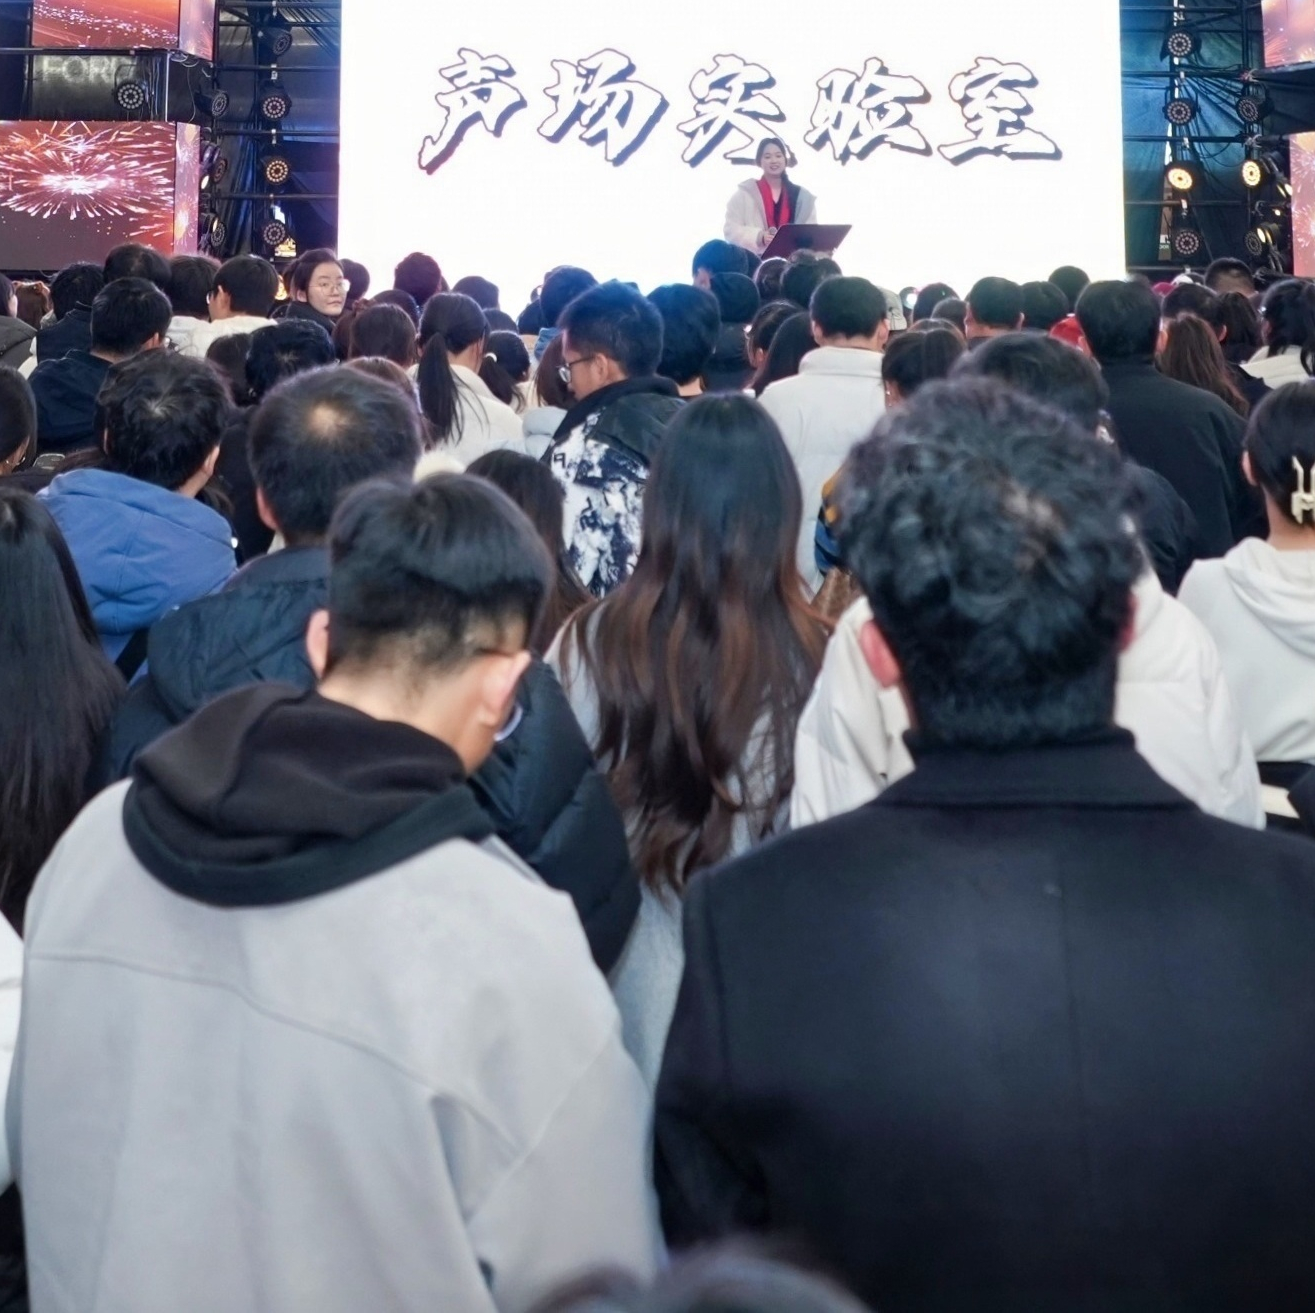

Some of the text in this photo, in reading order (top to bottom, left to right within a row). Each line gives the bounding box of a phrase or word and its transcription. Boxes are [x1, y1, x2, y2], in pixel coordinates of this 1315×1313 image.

[417, 47, 1064, 176] 声场实验室
